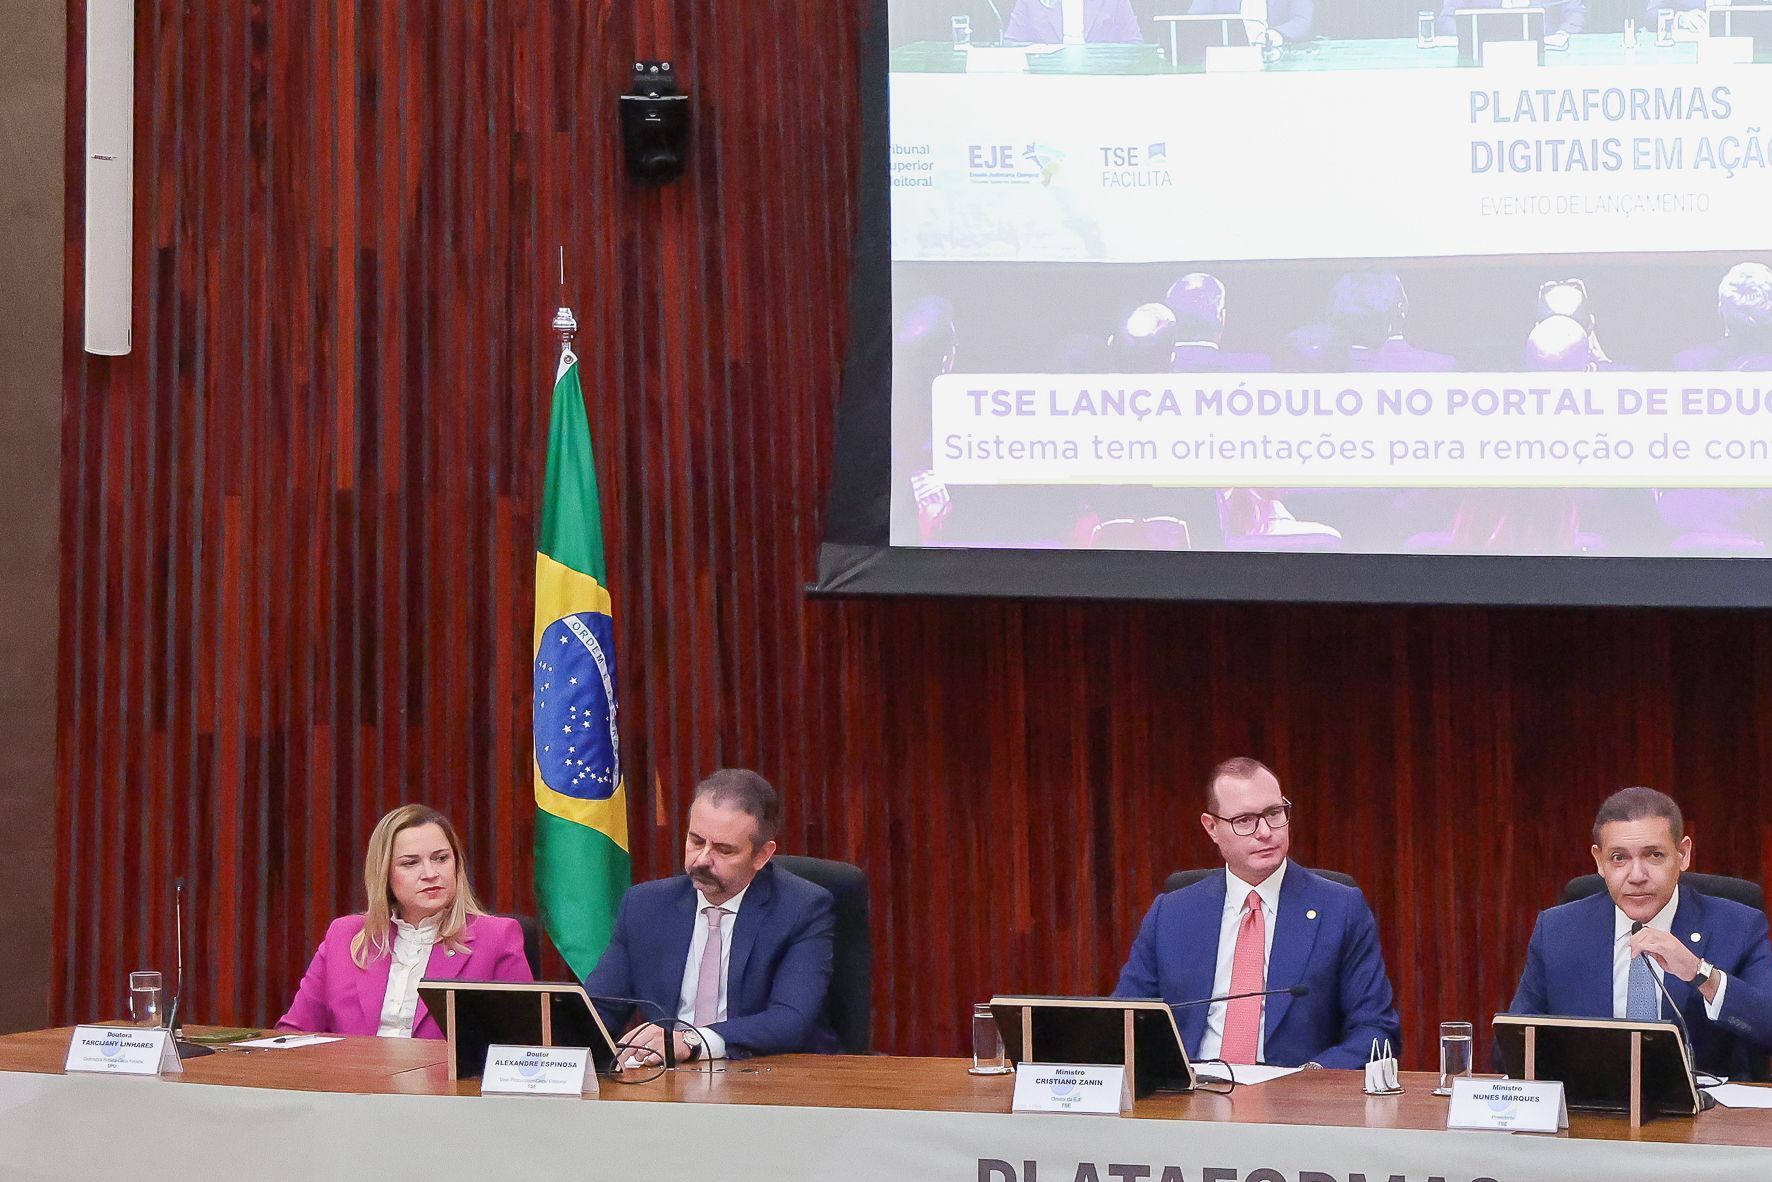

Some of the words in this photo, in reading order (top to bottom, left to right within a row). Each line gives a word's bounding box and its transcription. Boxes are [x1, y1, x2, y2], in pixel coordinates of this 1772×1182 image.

[1470, 87, 1732, 123] PLATAFORMAS
[969, 145, 1014, 168] EJE
[1100, 147, 1138, 167] TSE
[1471, 138, 1623, 173] DIGITAIS
[1633, 138, 1683, 170] EM
[1102, 170, 1172, 187] FACILITA
[1481, 195, 1551, 216] EVENTO
[1557, 195, 1579, 215] DE
[968, 390, 1035, 416] TSE
[1051, 390, 1181, 422] LANÇA
[1196, 382, 1363, 416] MÓDULO
[1378, 389, 1433, 416] NO
[1448, 389, 1603, 416] PORTAL
[1618, 389, 1667, 415] DE
[945, 434, 1079, 460] Sistema
[1093, 437, 1157, 460] tem
[1172, 433, 1375, 466] orientações
[1390, 439, 1464, 465] para
[1480, 433, 1634, 465] remoção
[1649, 432, 1690, 460] de
[571, 621, 605, 664] ORDEM
[120, 1041, 154, 1049] LINHARES
[1492, 1084, 1523, 1092] Ministro
